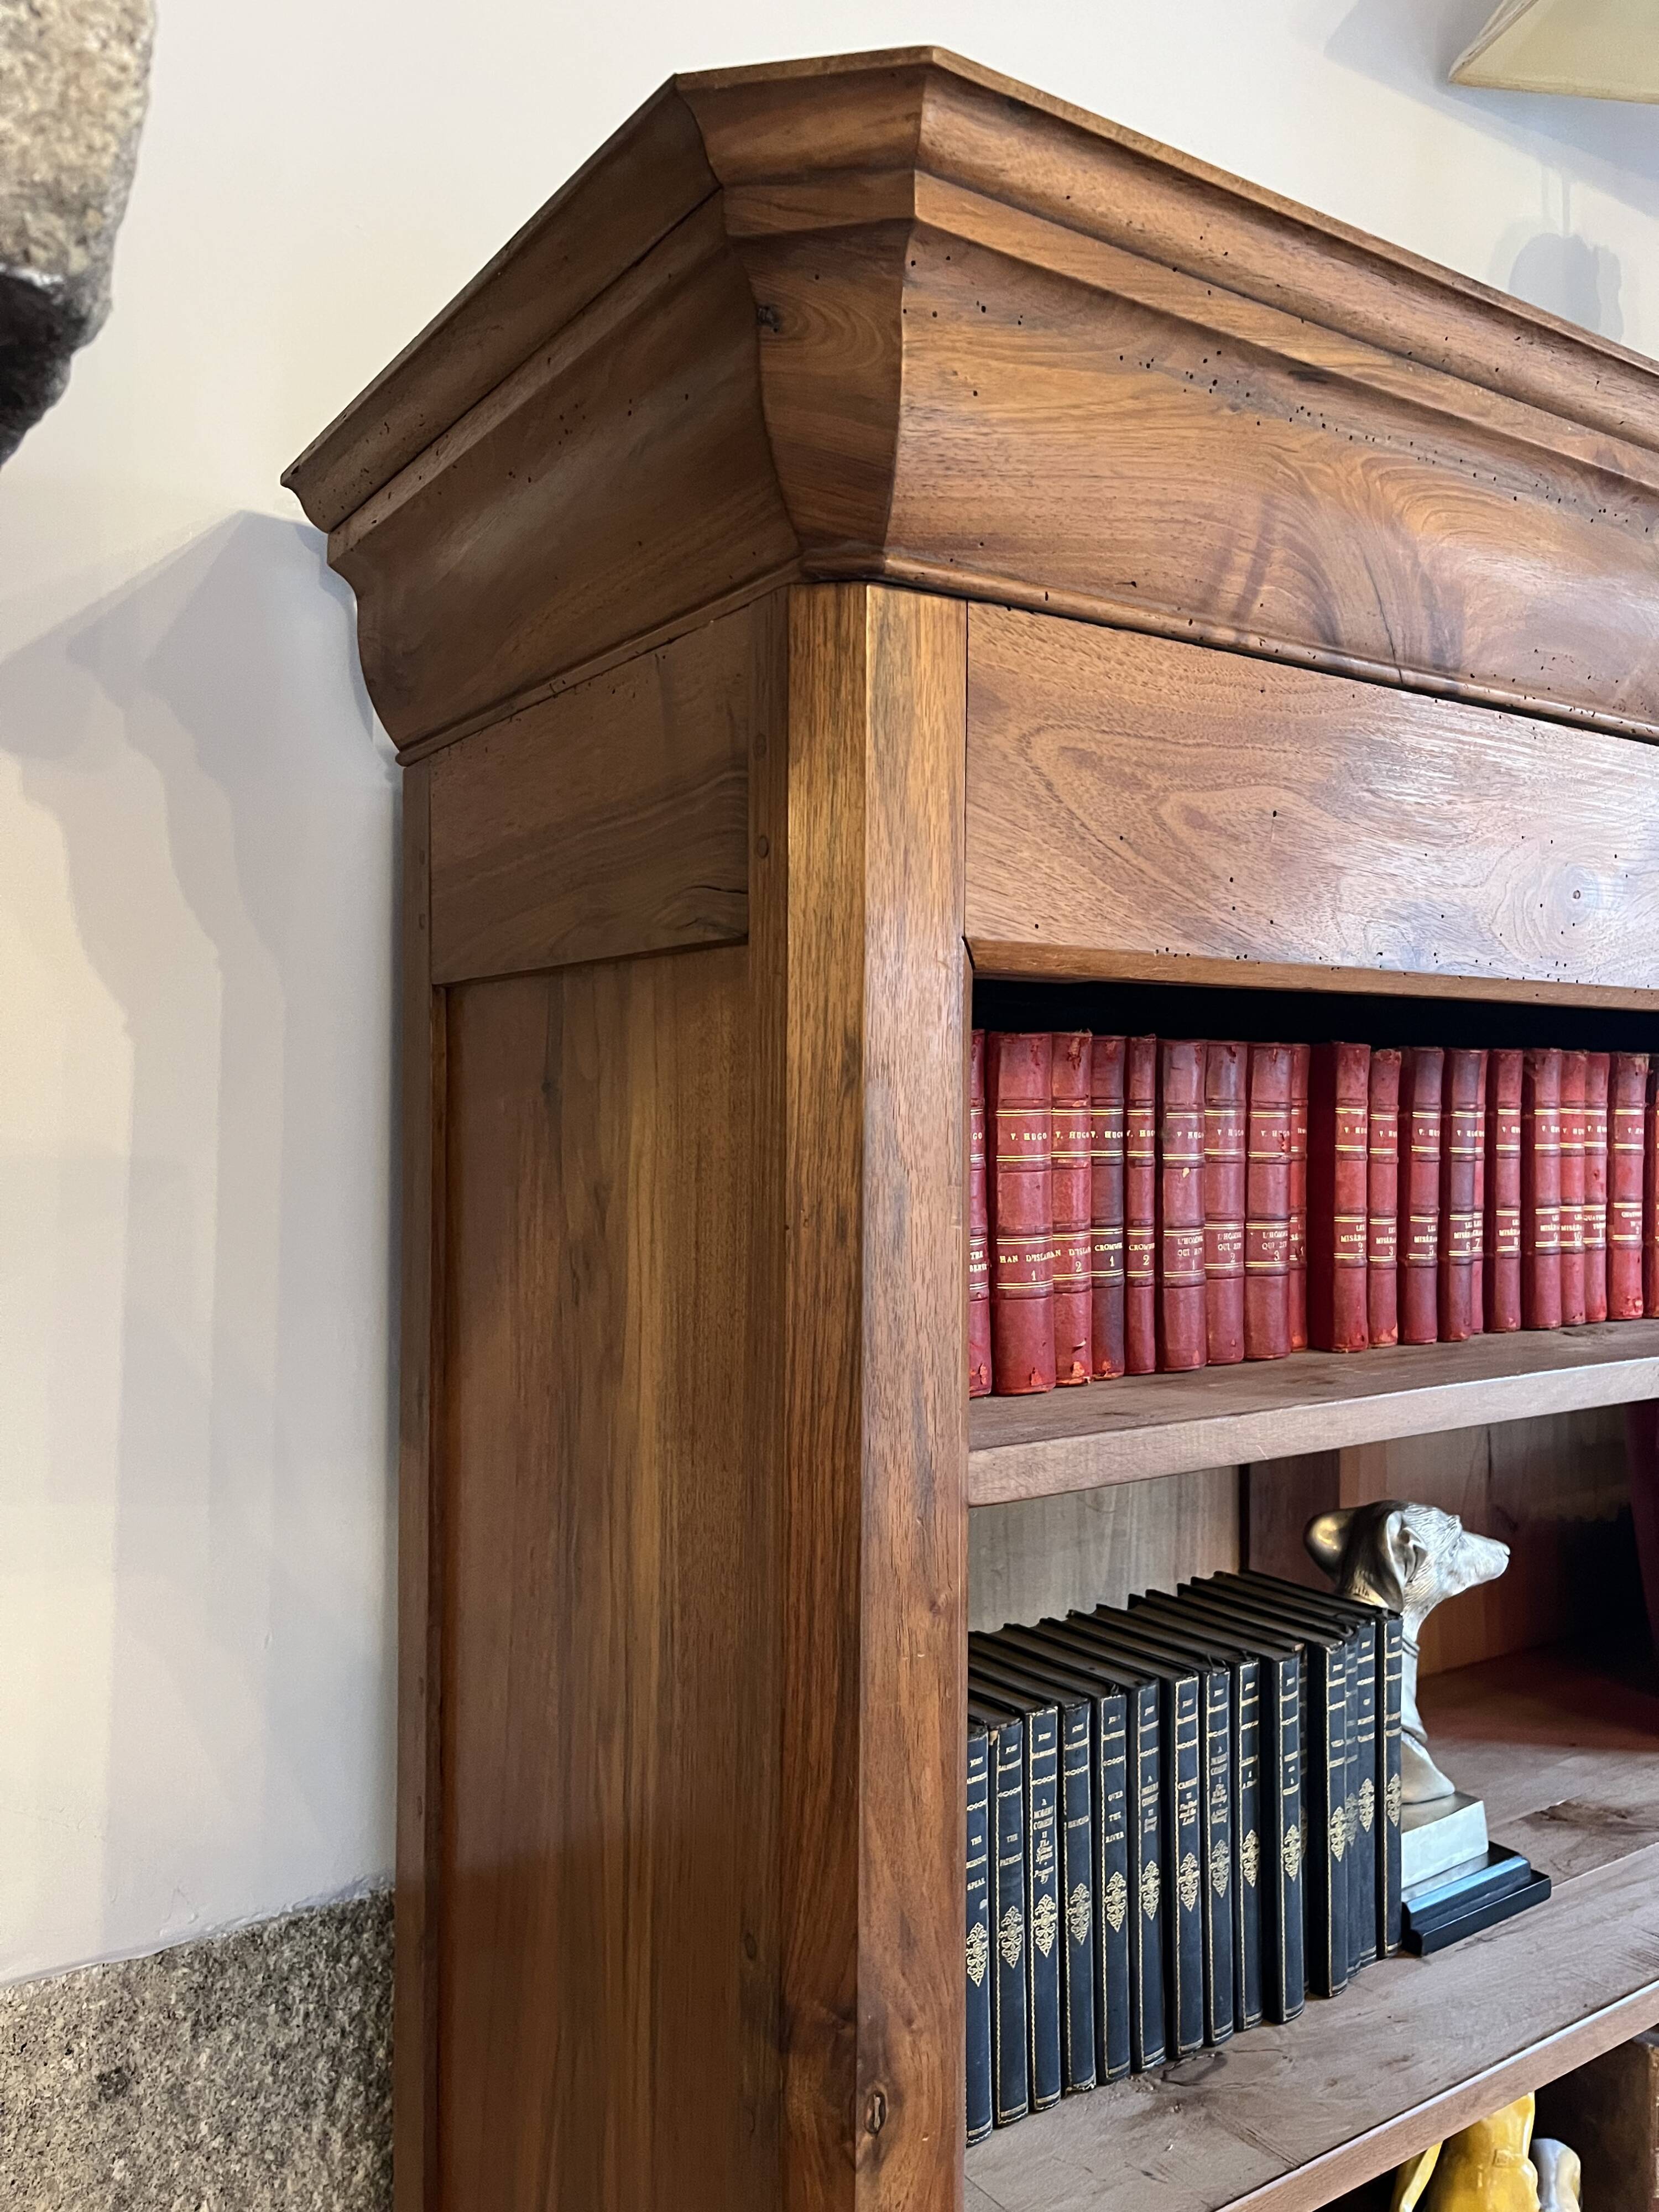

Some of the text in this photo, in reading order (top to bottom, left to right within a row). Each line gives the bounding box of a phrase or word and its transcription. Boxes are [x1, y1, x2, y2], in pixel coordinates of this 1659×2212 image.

[999, 1255, 1018, 1264] HAN
[1109, 1255, 1114, 1267] 1
[1142, 1254, 1150, 1266] 2
[1274, 1250, 1280, 1261] 3
[1075, 1261, 1082, 1272] 2
[1031, 1270, 1036, 1281] 1
